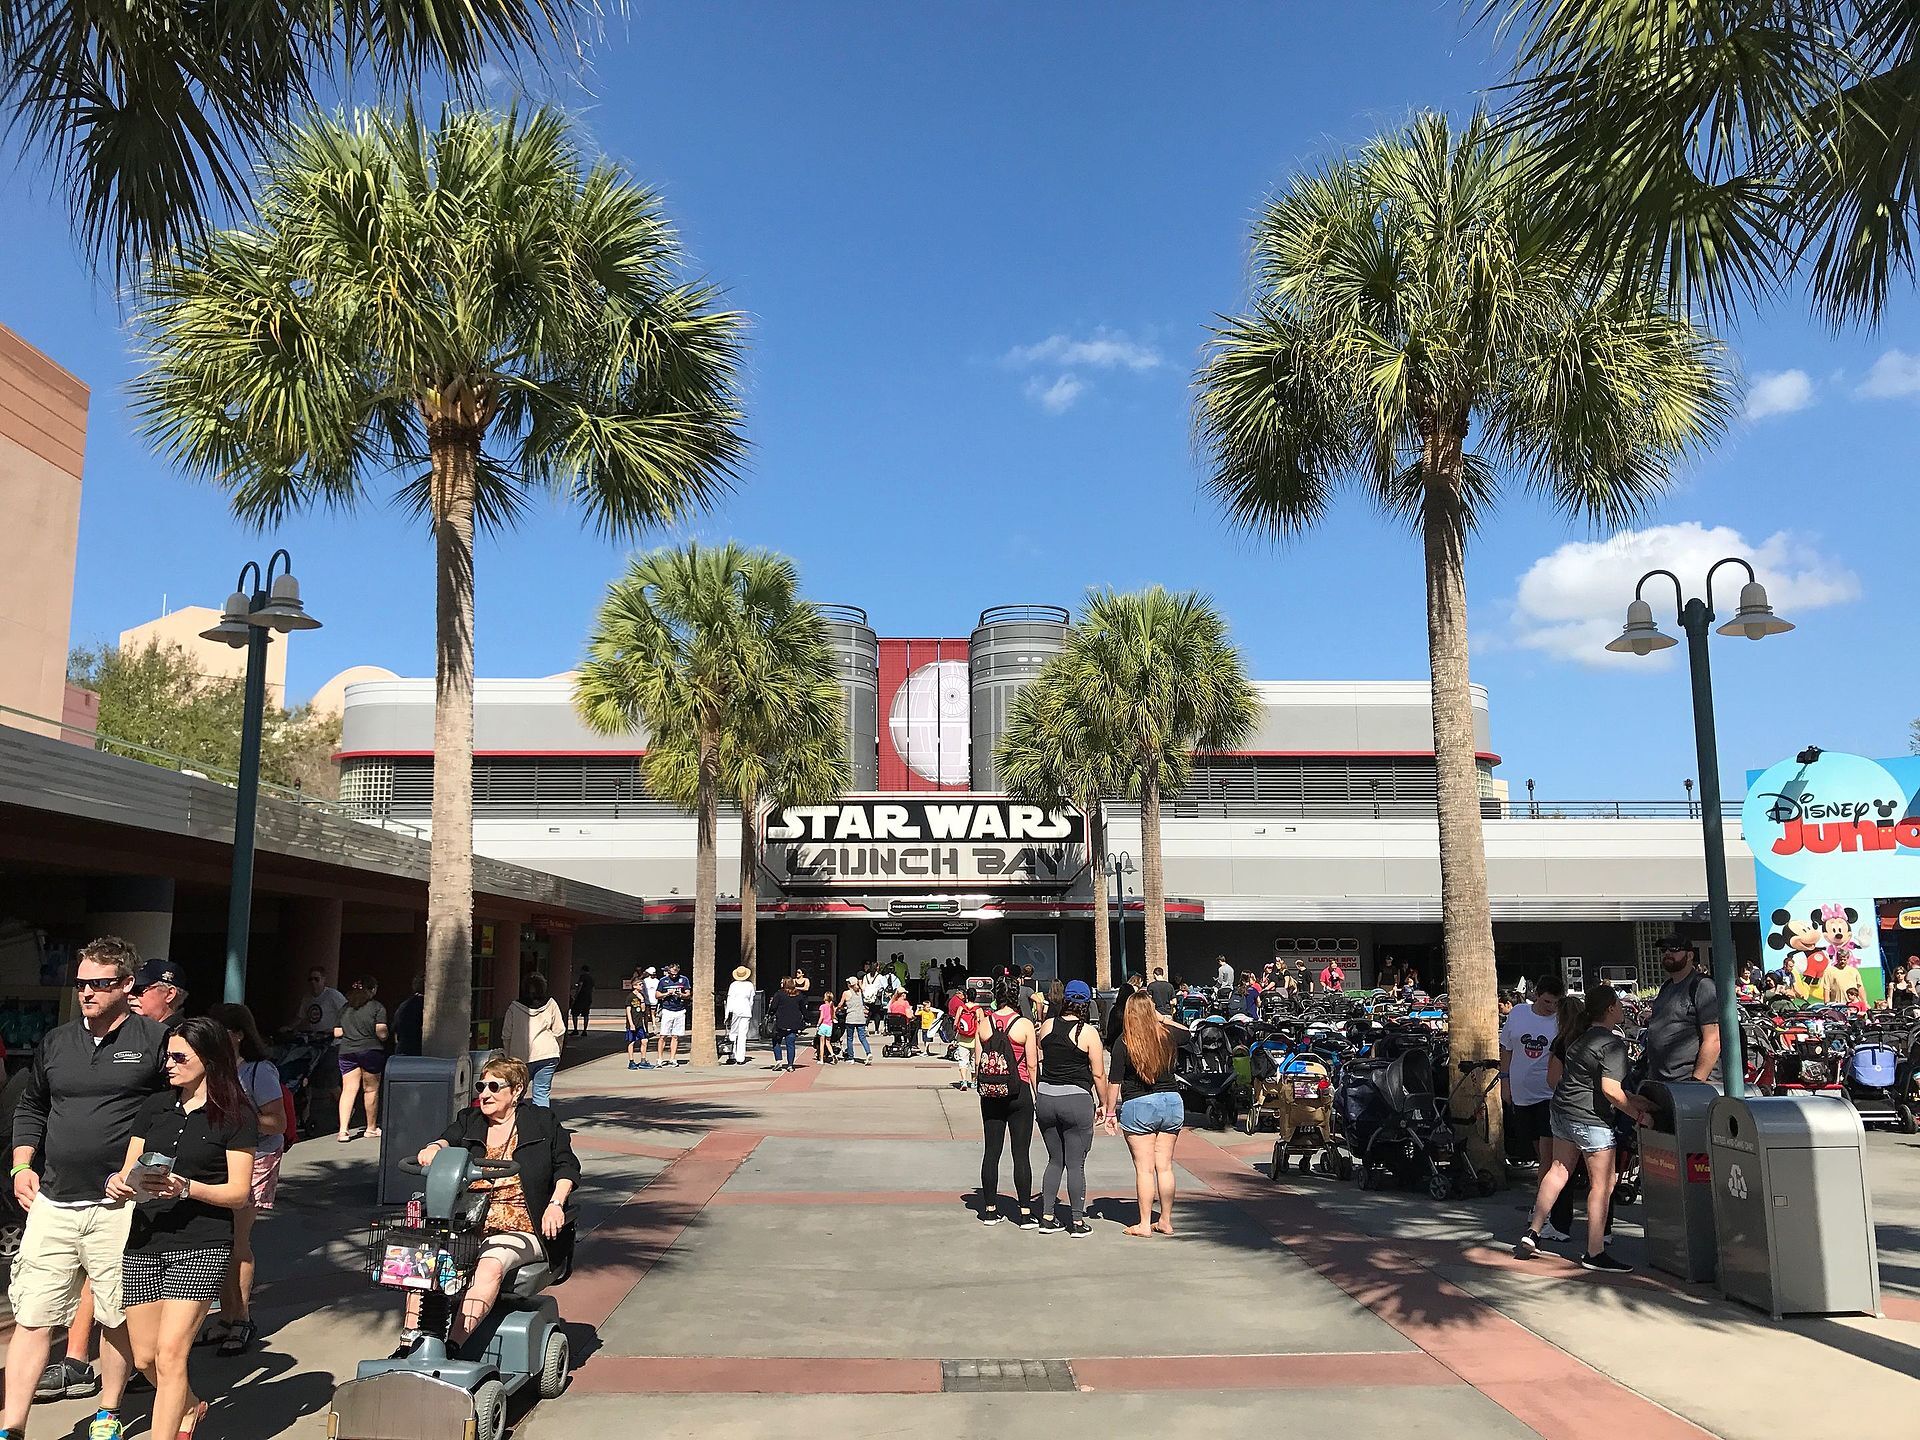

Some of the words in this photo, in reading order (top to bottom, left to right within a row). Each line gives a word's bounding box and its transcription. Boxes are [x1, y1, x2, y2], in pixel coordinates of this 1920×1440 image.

[768, 805, 921, 840] STAR
[923, 804, 1081, 840] WARS
[786, 848, 959, 876] LAUNCH
[972, 848, 1065, 876] BAY
